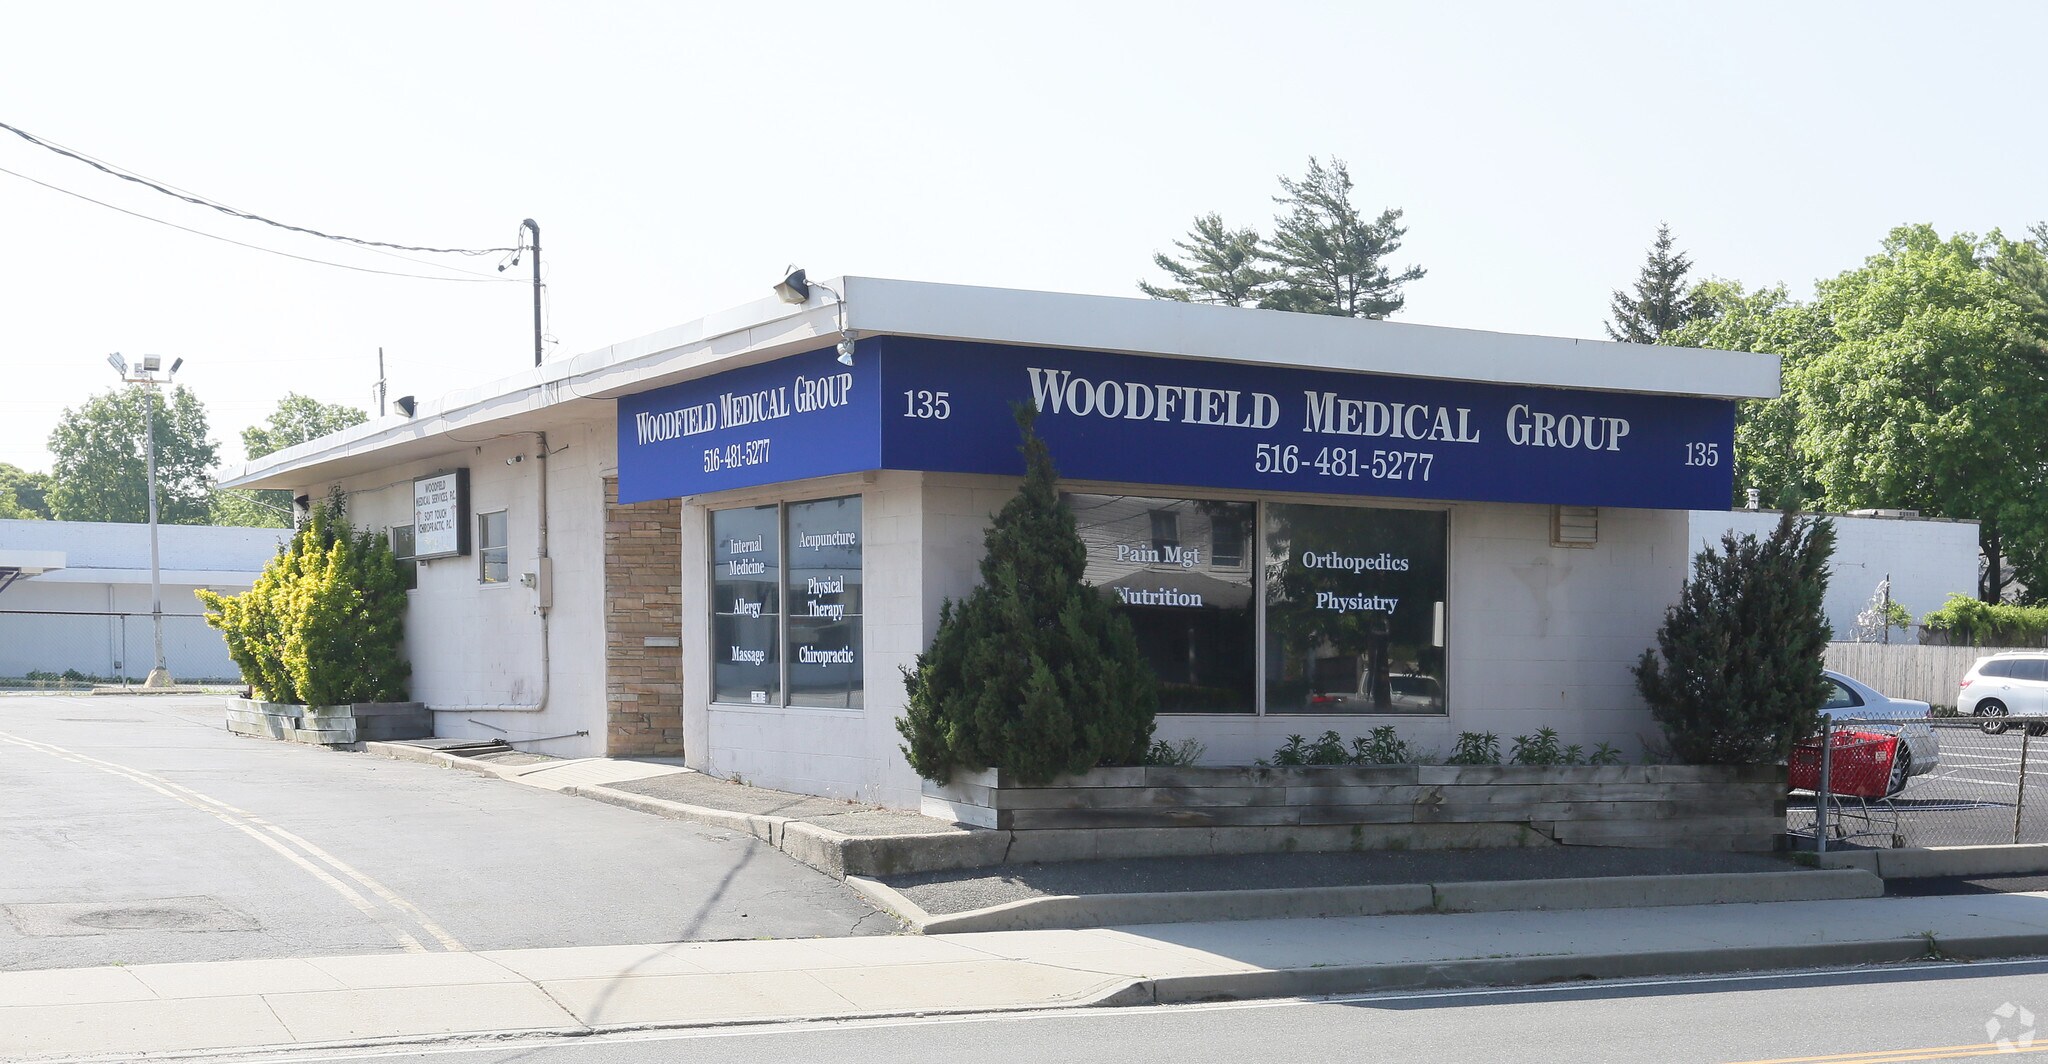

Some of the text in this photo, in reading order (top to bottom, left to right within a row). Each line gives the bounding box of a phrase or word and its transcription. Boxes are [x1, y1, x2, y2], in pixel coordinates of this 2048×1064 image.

[635, 372, 853, 446] WOODFIELD MEDICAL GROUP
[903, 390, 951, 420] 135
[1027, 367, 1631, 451] WOODFIELD MEDICAL GROUP
[704, 438, 771, 473] 516-481-5277
[1255, 443, 1434, 482] 516-481-5277
[1685, 442, 1719, 467] 135
[425, 480, 446, 493] WOODFIELD
[424, 508, 447, 521] SOFT TOUCH
[730, 535, 762, 554] Internal
[799, 530, 856, 551] Acupuncture
[729, 558, 765, 576] Medicine
[1116, 544, 1200, 568] Pain Mgt
[1302, 551, 1409, 574] Orthopedics
[808, 575, 844, 599] Physical
[733, 598, 762, 619] Allergy
[808, 600, 844, 621] Therapy
[1316, 592, 1399, 615] Physiatry
[732, 646, 765, 666] Massage
[799, 645, 854, 667] Chiropractic
